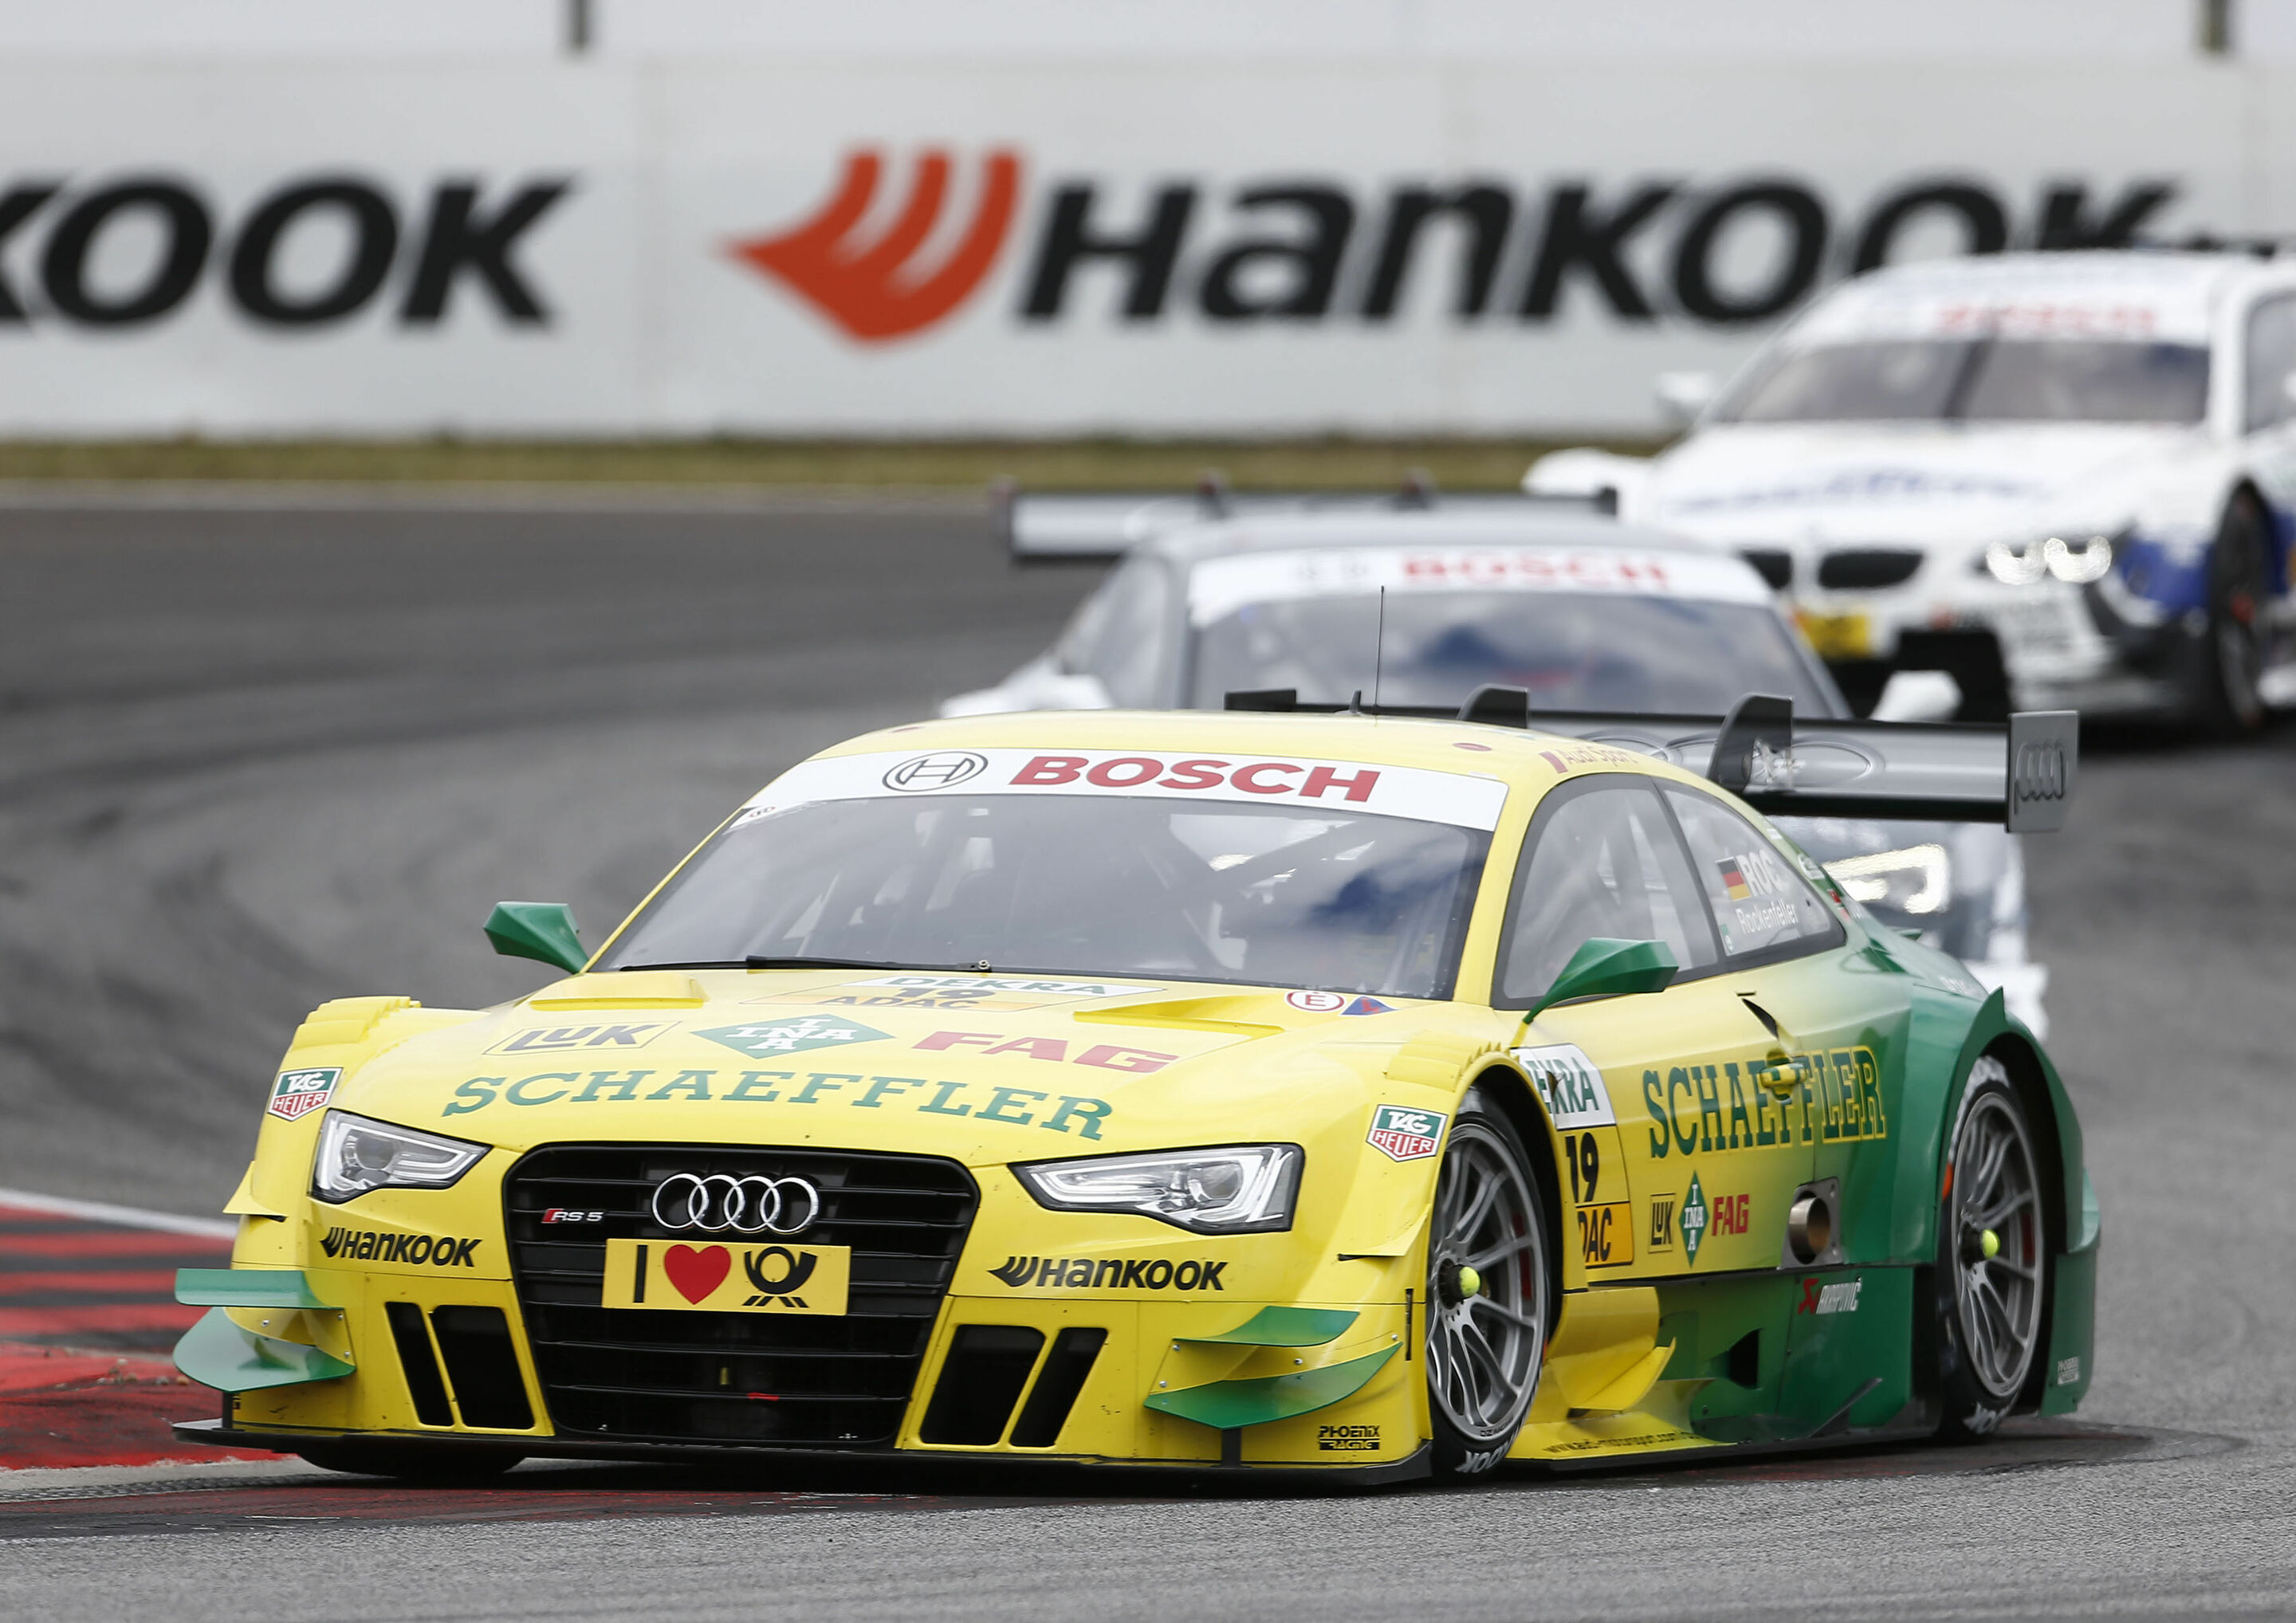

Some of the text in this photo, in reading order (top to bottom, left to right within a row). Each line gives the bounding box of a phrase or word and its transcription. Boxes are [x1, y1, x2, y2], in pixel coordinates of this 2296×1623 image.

[1008, 756, 1381, 803] BOSCH
[816, 996, 980, 1009] ADAC
[887, 977, 1106, 994] DEKRA
[894, 988, 997, 999] 19
[911, 1031, 1180, 1073] FAG
[286, 1071, 327, 1093] TAG
[1521, 1057, 1599, 1114] EKRA
[274, 1093, 325, 1115] HEUER
[441, 1071, 1113, 1141] SCHAEFFLER
[1388, 1111, 1432, 1134] TAG
[1374, 1131, 1433, 1156] HEUER
[1565, 1132, 1599, 1203] 19
[1578, 1208, 1612, 1263] DAC
[1712, 1193, 1750, 1236] FAG
[633, 1244, 648, 1303] I
